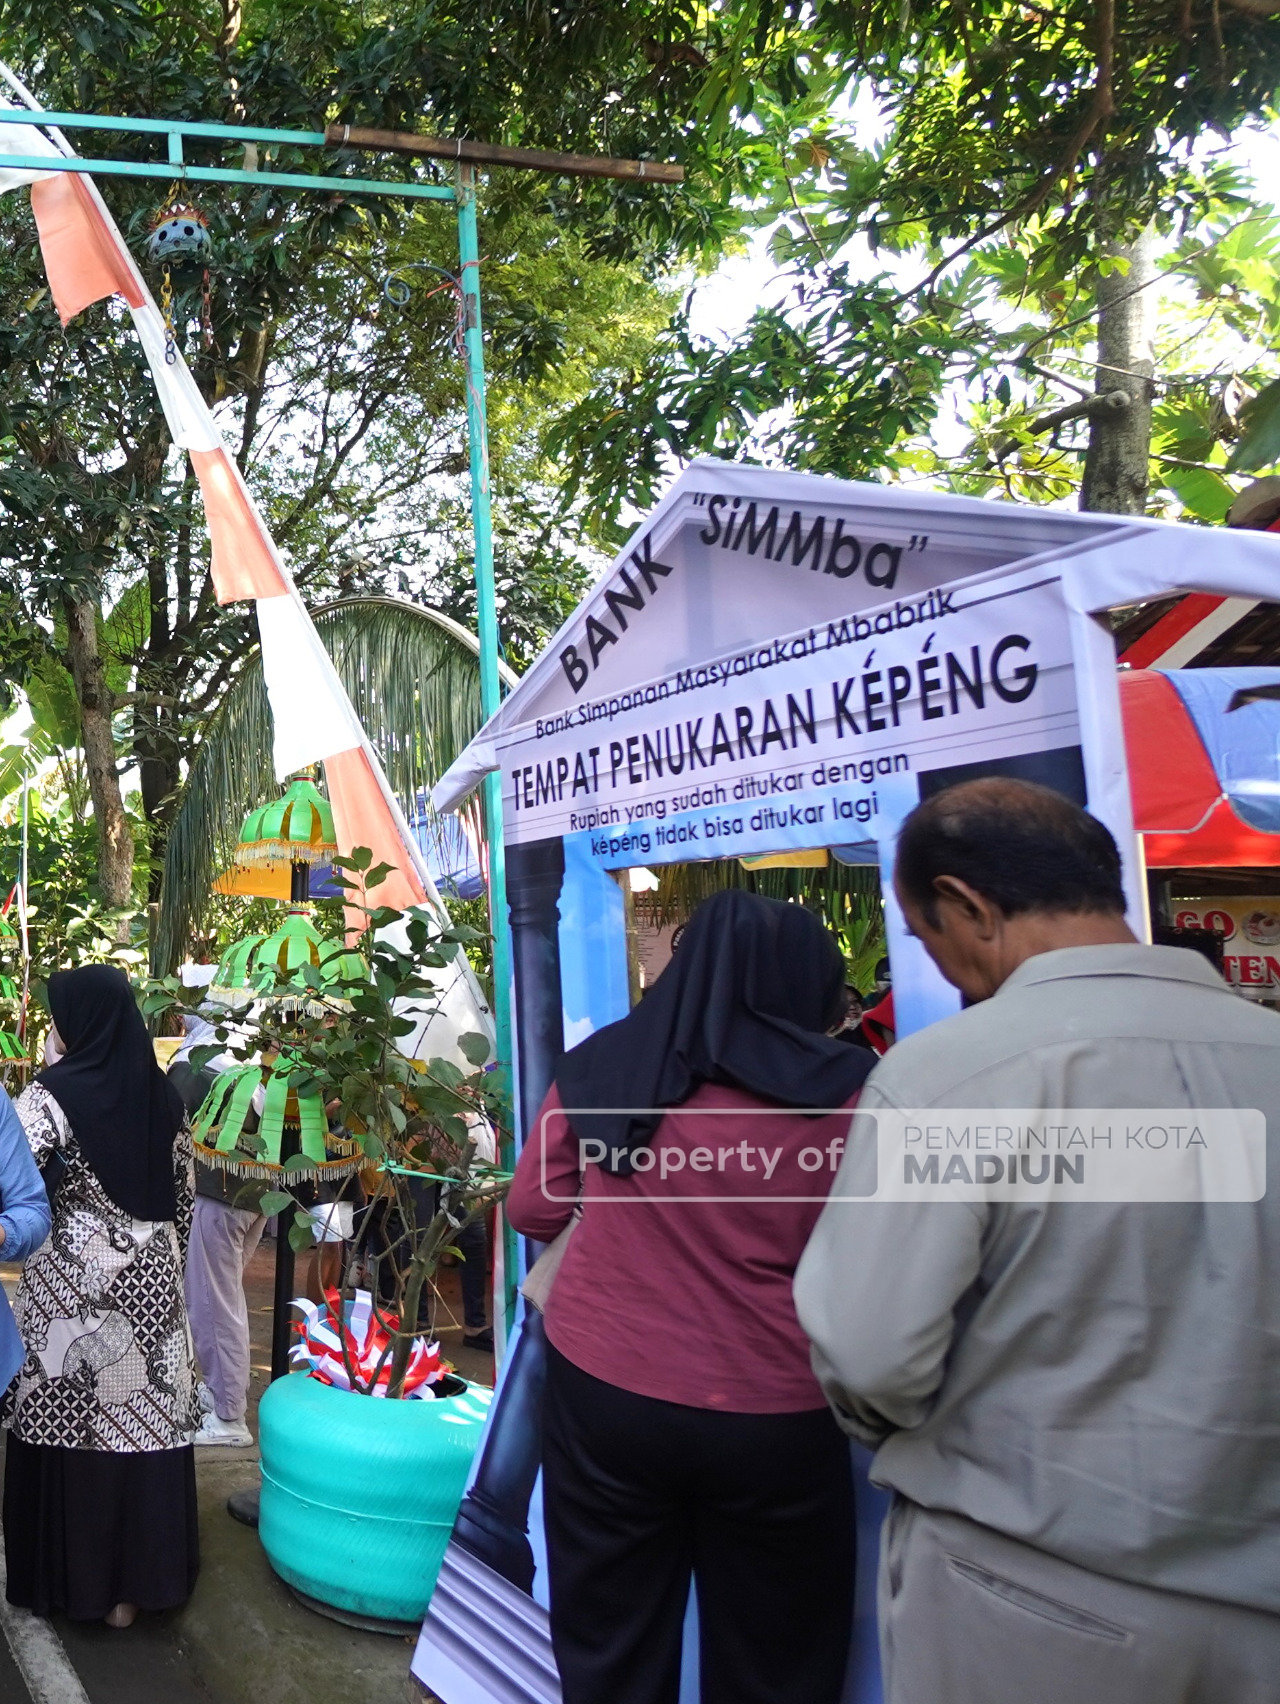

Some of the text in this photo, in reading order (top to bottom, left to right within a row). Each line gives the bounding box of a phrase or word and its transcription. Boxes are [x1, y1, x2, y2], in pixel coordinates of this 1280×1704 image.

[535, 588, 958, 739] Bank Simpanan Masyarakat Mbabrik
[559, 533, 674, 693] BANK
[512, 631, 1038, 811] TEMPAT PENUKARAN KÉPÉNG
[570, 752, 910, 832] Rupiah yang sudah ditukar dengan
[591, 791, 879, 858] képéng tidak bisa ditukar lagi
